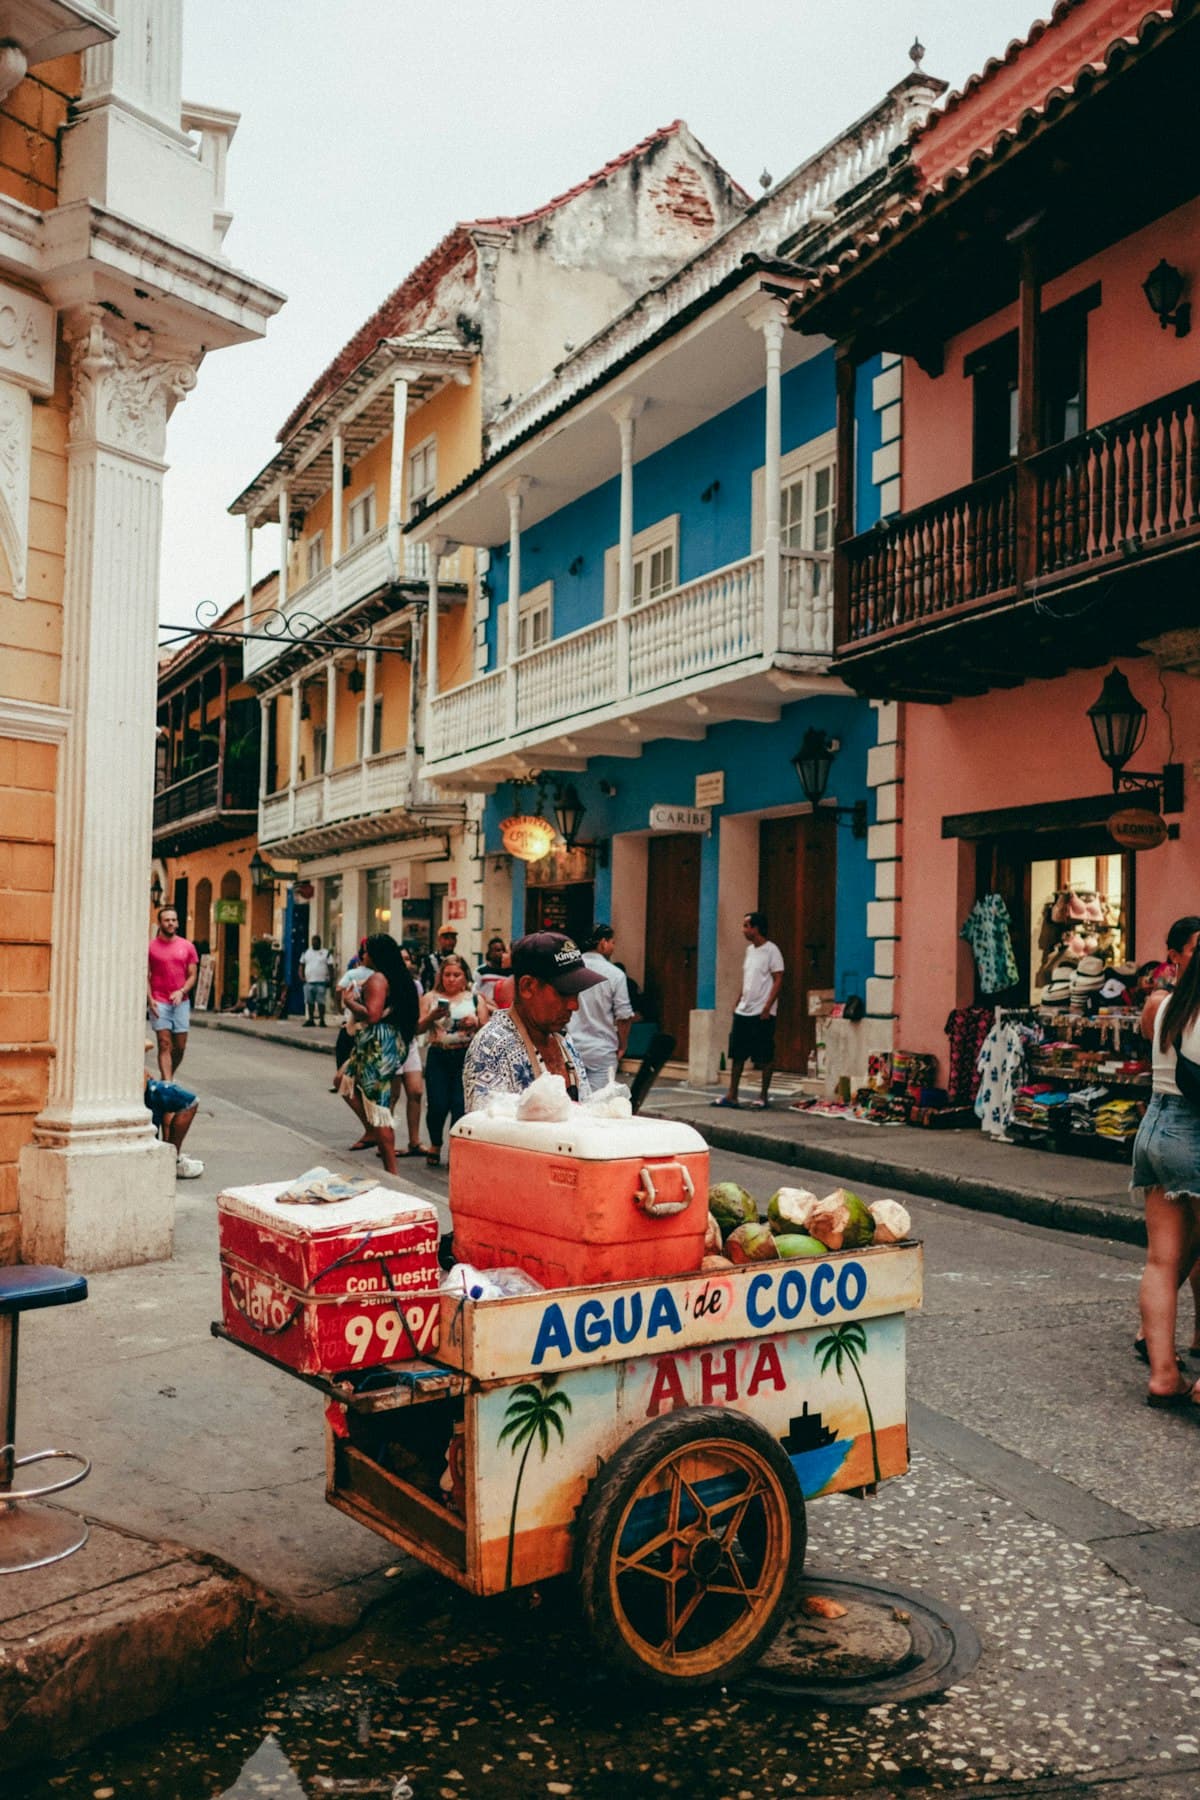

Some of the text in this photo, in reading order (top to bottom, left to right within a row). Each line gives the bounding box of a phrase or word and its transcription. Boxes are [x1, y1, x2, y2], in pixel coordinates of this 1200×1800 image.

[656, 811, 706, 825] CARIBE
[346, 1277, 378, 1293] Con
[531, 1261, 867, 1365] AGUA de COCO
[345, 1303, 440, 1364] 99%
[645, 1342, 787, 1417] AHA
